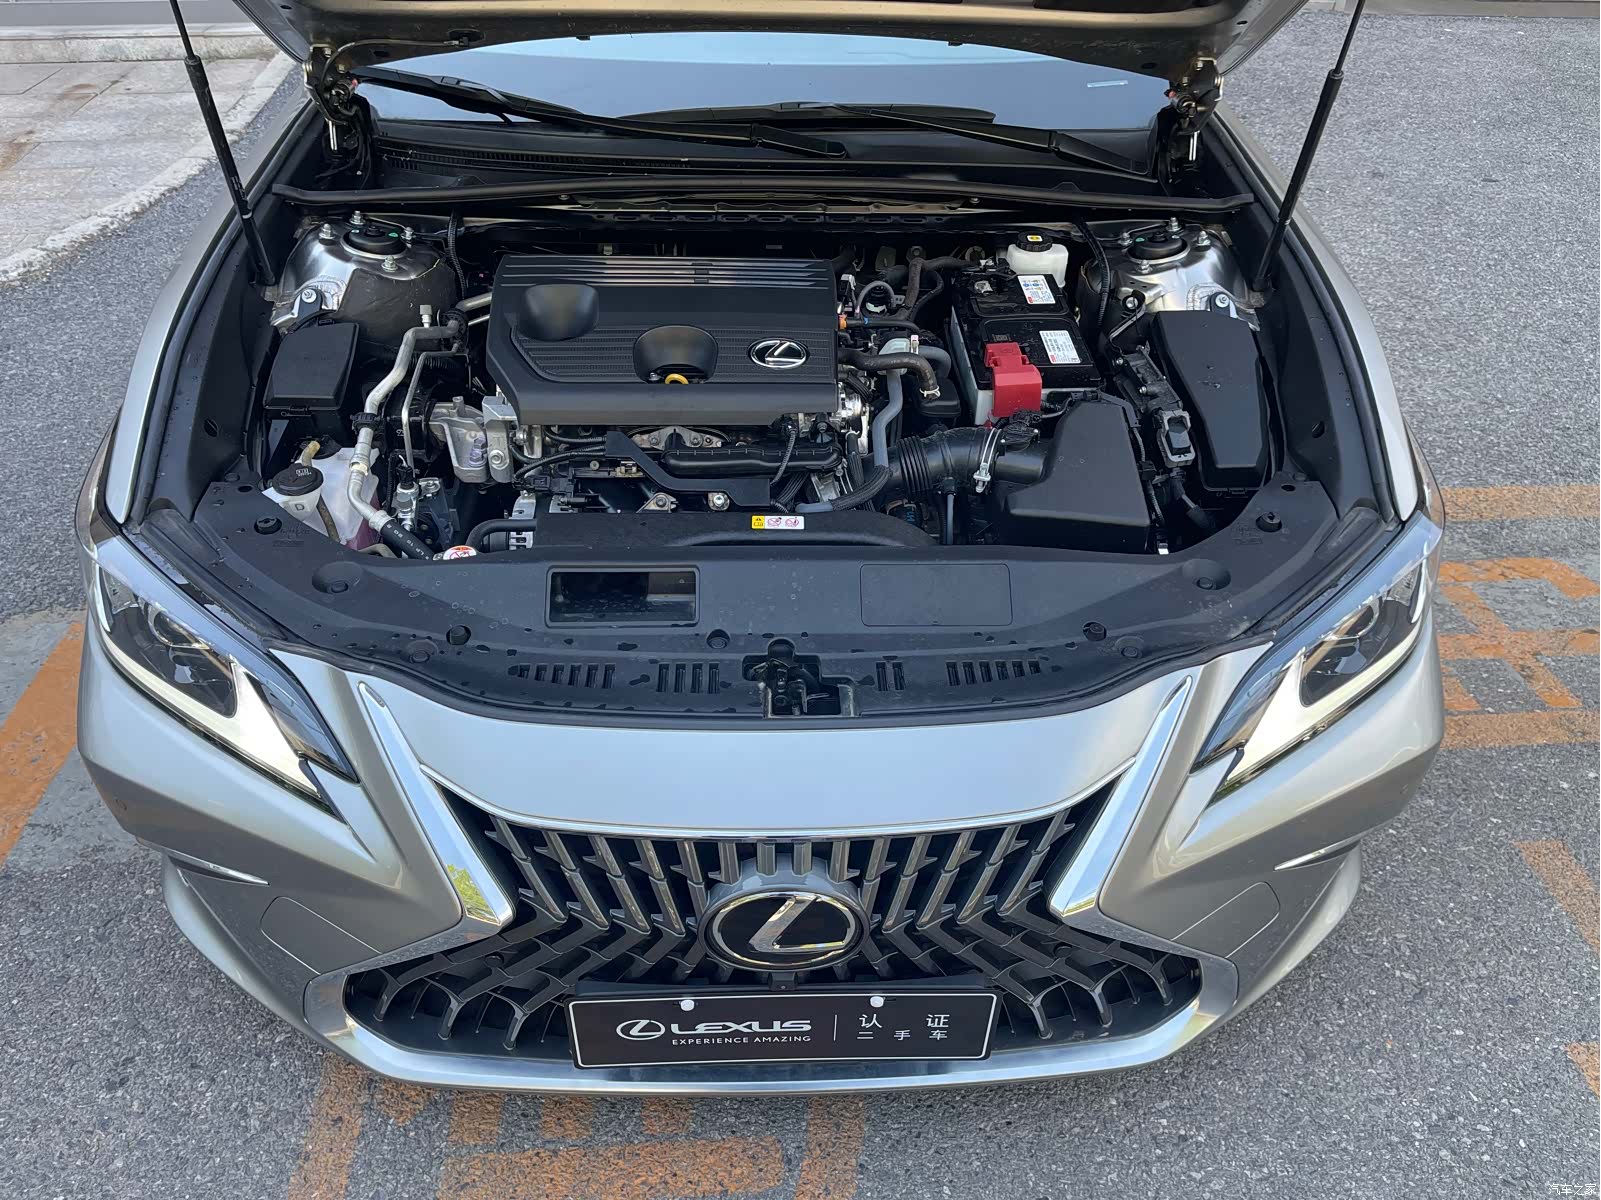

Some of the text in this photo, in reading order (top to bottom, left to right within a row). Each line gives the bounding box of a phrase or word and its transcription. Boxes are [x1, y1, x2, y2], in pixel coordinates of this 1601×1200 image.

[670, 1019, 812, 1035] LEXUS
[672, 1035, 812, 1046] EXPERIENCE AMAZING
